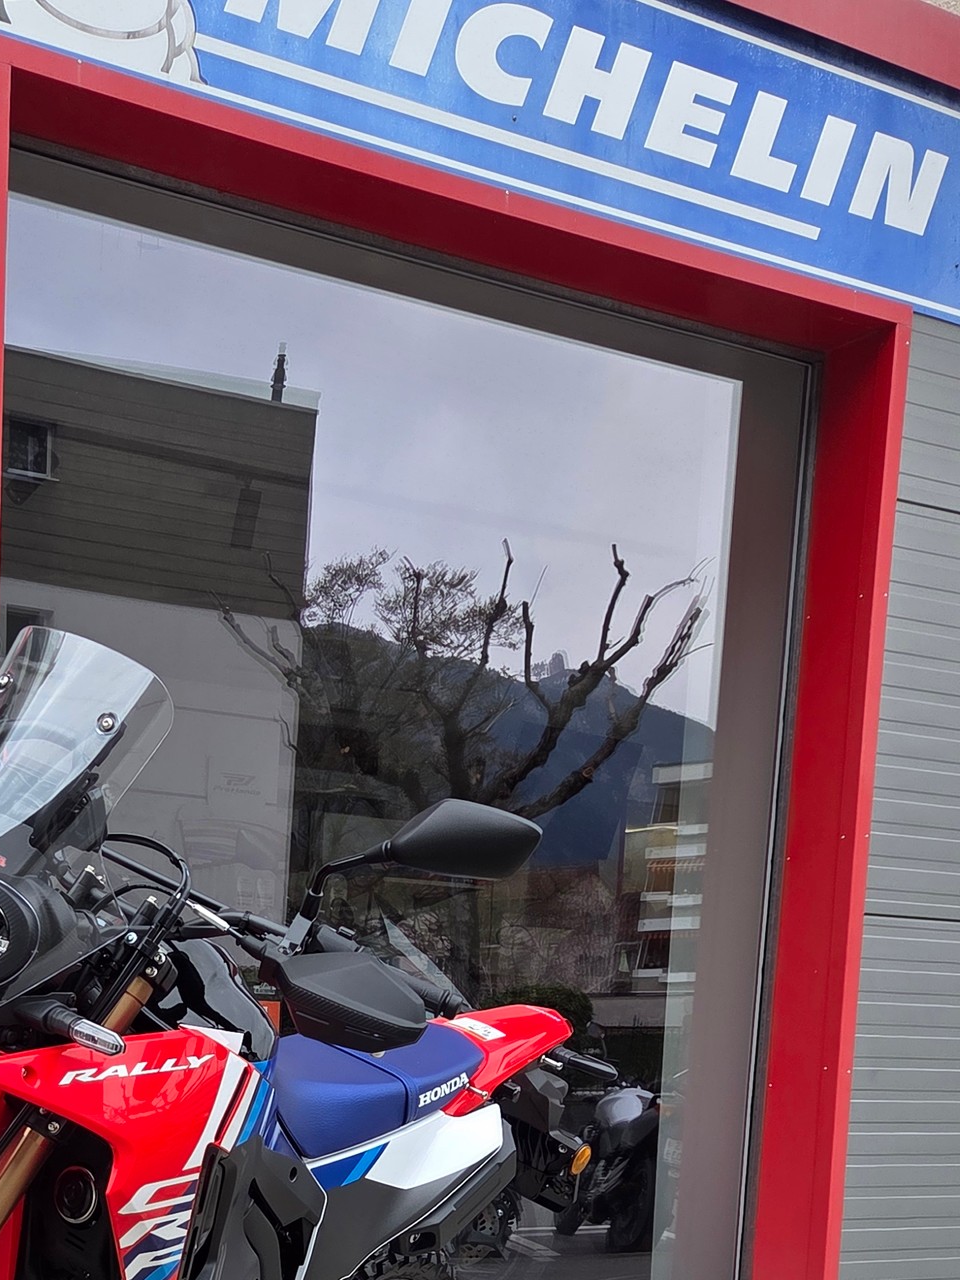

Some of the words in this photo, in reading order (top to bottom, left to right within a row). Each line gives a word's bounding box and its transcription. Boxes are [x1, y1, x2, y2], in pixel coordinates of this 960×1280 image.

[224, 0, 949, 236] MICHELIN
[58, 1054, 214, 1086] RALLY
[418, 1072, 469, 1108] HONDA
